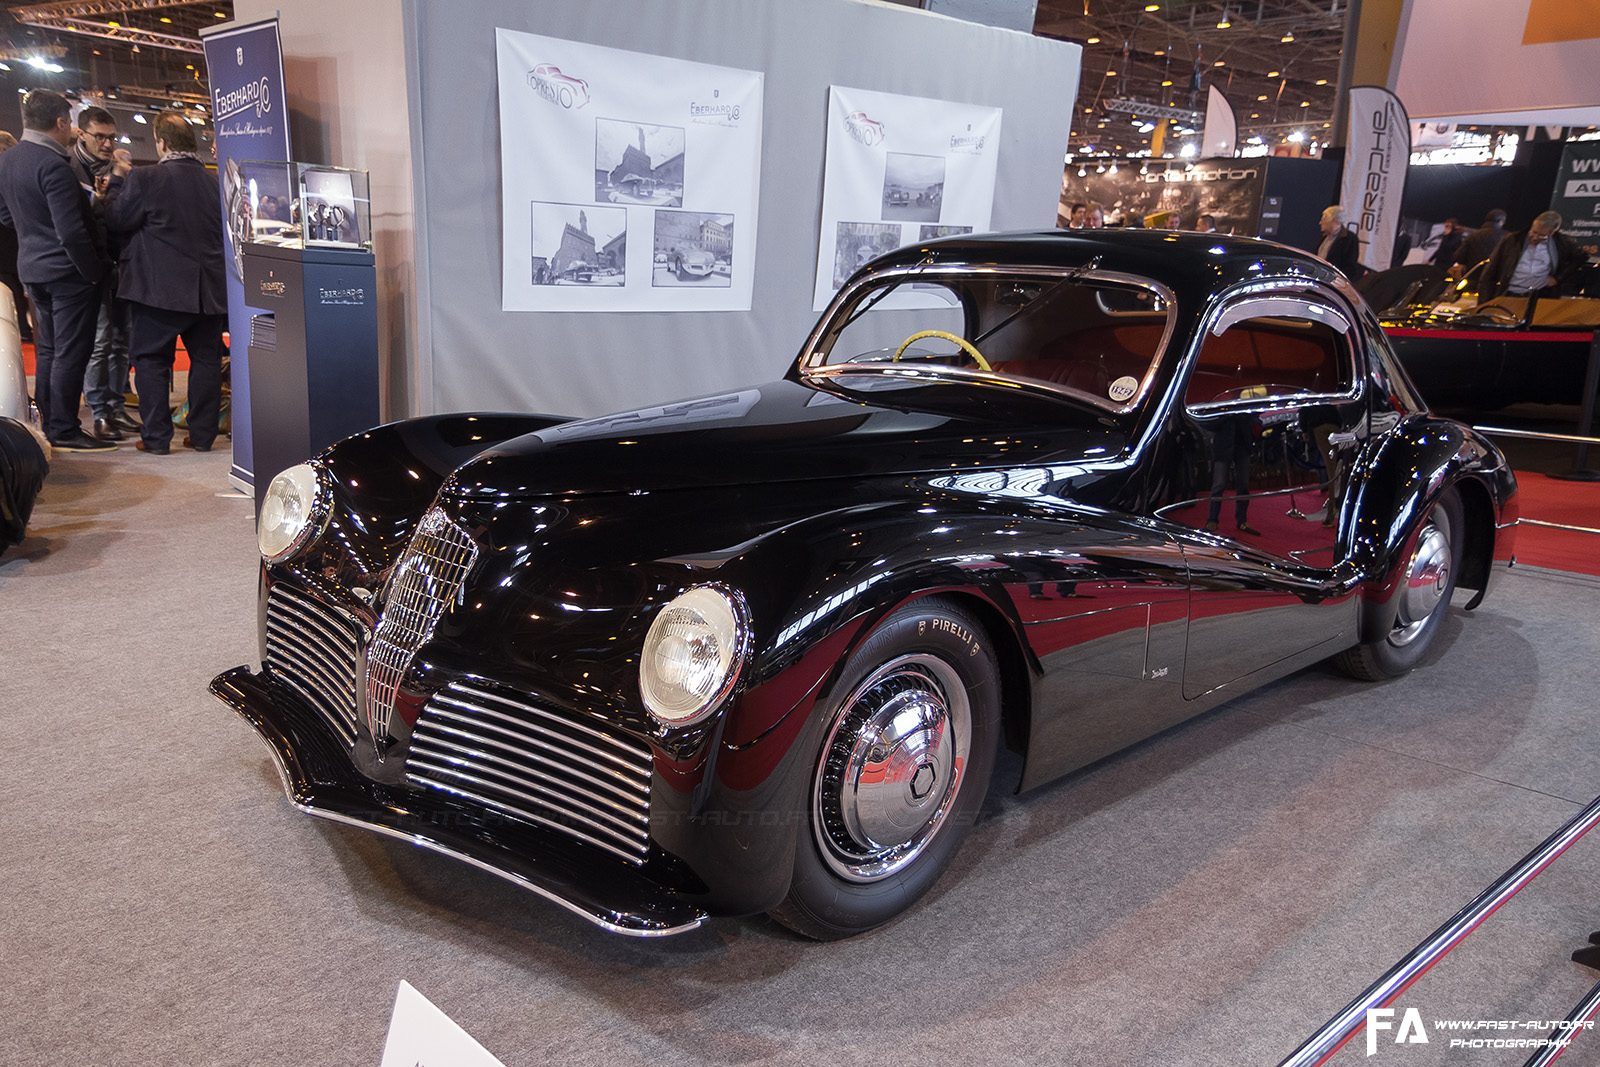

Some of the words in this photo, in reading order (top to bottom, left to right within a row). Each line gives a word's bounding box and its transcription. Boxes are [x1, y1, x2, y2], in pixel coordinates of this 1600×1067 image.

[215, 80, 259, 116] EBERHARD
[690, 101, 732, 115] EBERHARD
[932, 618, 972, 644] PIRELLI
